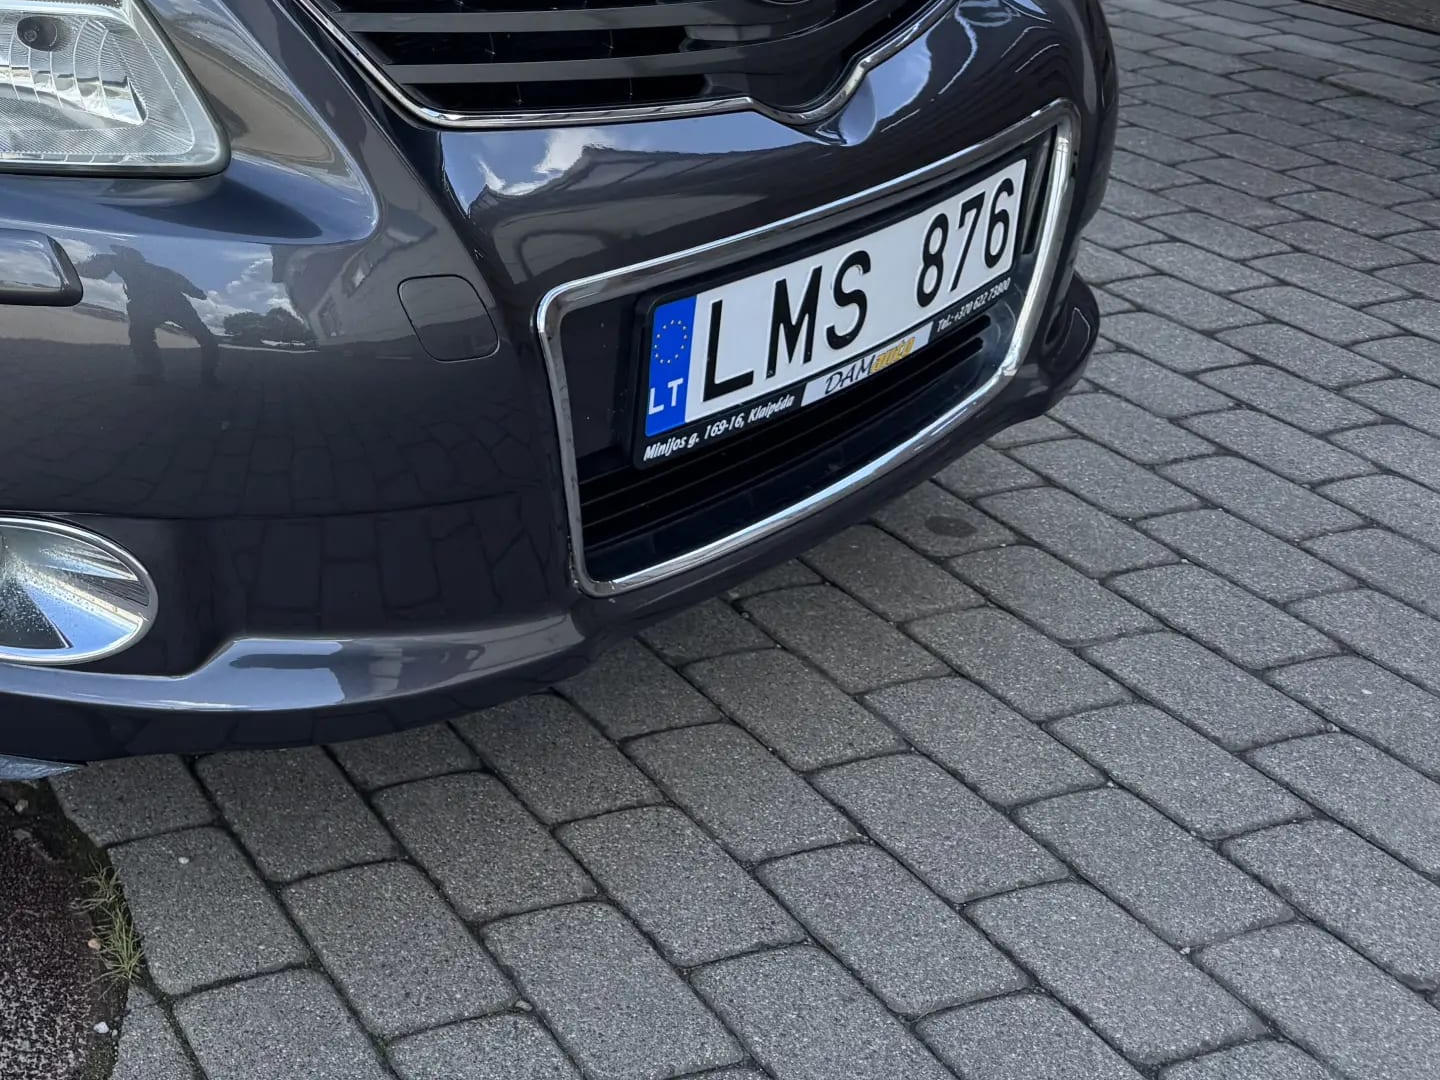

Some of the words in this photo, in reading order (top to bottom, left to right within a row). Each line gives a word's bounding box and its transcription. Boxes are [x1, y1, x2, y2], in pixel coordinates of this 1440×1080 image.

[703, 250, 871, 402] LMS
[916, 177, 1015, 308] 876
[648, 378, 684, 415] LT
[643, 436, 687, 461] Minijos
[687, 433, 700, 448] g.
[704, 413, 745, 440] 169-16,
